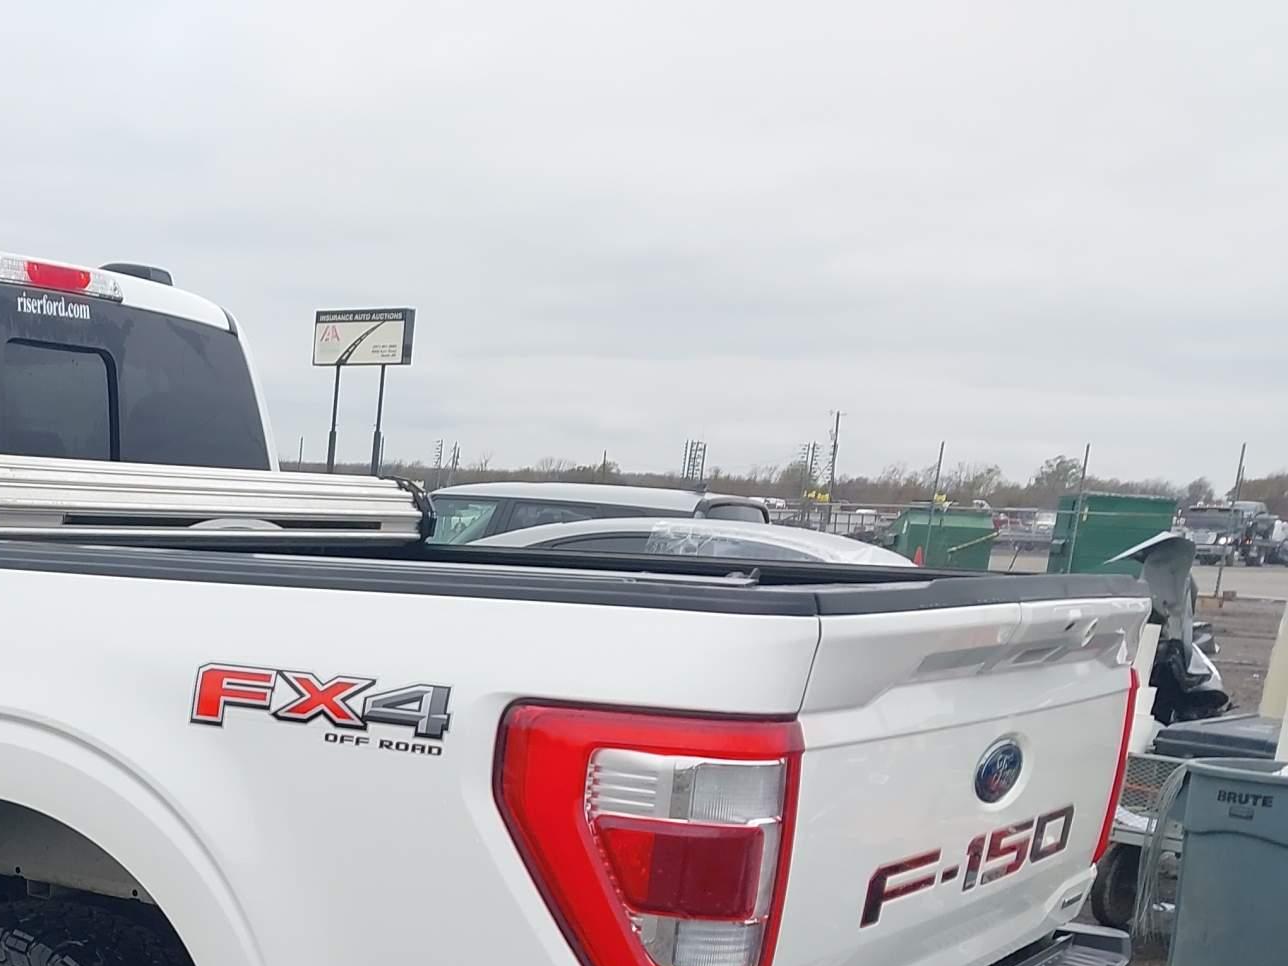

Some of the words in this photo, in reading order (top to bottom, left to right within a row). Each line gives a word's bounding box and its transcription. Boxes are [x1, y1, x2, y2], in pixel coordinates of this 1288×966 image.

[16, 291, 91, 319] riserford.com
[372, 312, 403, 320] AUCTIONS
[190, 662, 452, 739] FX4
[324, 732, 370, 746] OFF
[378, 739, 443, 756] ROAD
[1216, 789, 1274, 808] BRUTE
[859, 804, 1075, 929] F-150
